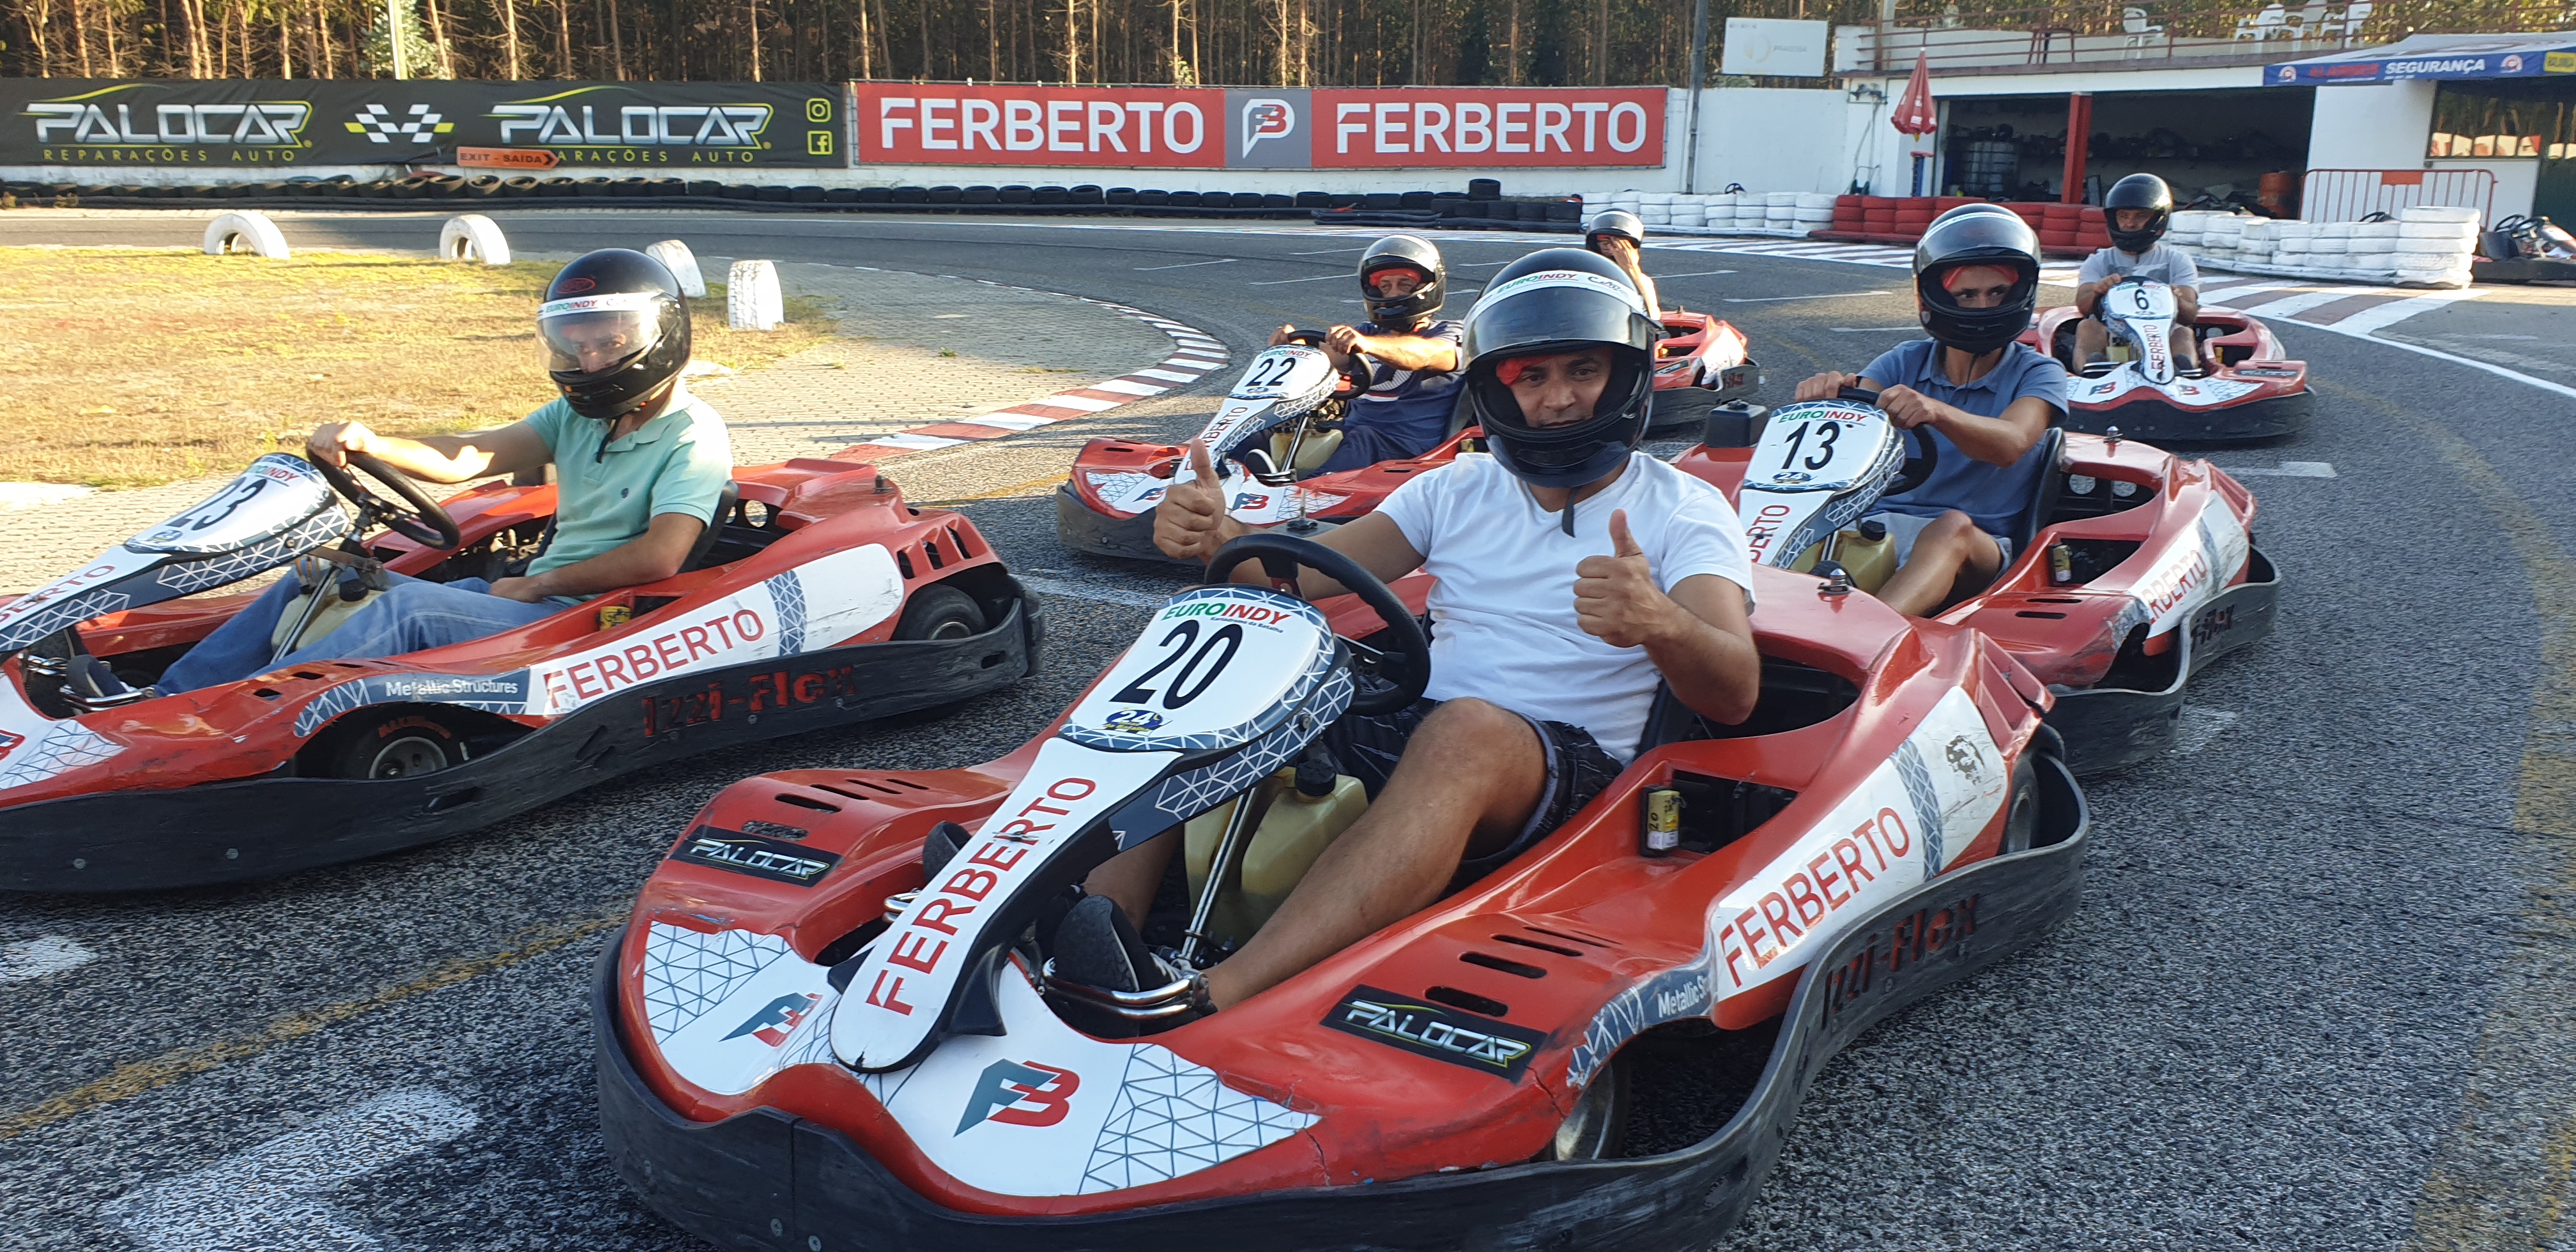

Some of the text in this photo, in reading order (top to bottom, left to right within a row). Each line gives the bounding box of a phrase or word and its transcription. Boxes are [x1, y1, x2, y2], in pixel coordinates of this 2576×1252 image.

[2384, 58, 2486, 75] SEGURANÇA
[26, 103, 307, 144] PALOCAR
[491, 105, 769, 145] PALOCAR
[880, 97, 1204, 154] FERBERTO
[1337, 102, 1647, 153] FERBERTO
[43, 148, 296, 162] REPARAÇÕES AUTO
[460, 152, 491, 161] EXIT
[558, 149, 754, 162] ARAÇÕES AUTO
[1497, 272, 1577, 293] EUROINDY
[2135, 289, 2149, 310] 6
[1244, 357, 1296, 387] 22
[1777, 410, 1869, 424] EUROINDY
[1781, 421, 1841, 471] 13
[1162, 602, 1292, 625] EUROINDY
[544, 609, 765, 709] FERBERTO
[1108, 620, 1243, 710] 20
[385, 678, 519, 697] Metallic Structures
[1111, 710, 1155, 725] 24
[689, 838, 827, 878] PALOCAR
[866, 777, 1096, 1016] FERBERTO
[1719, 807, 1910, 988] FERBERTO
[1657, 981, 1700, 1018] Metallic
[1346, 1000, 1529, 1065] PALOCAR
